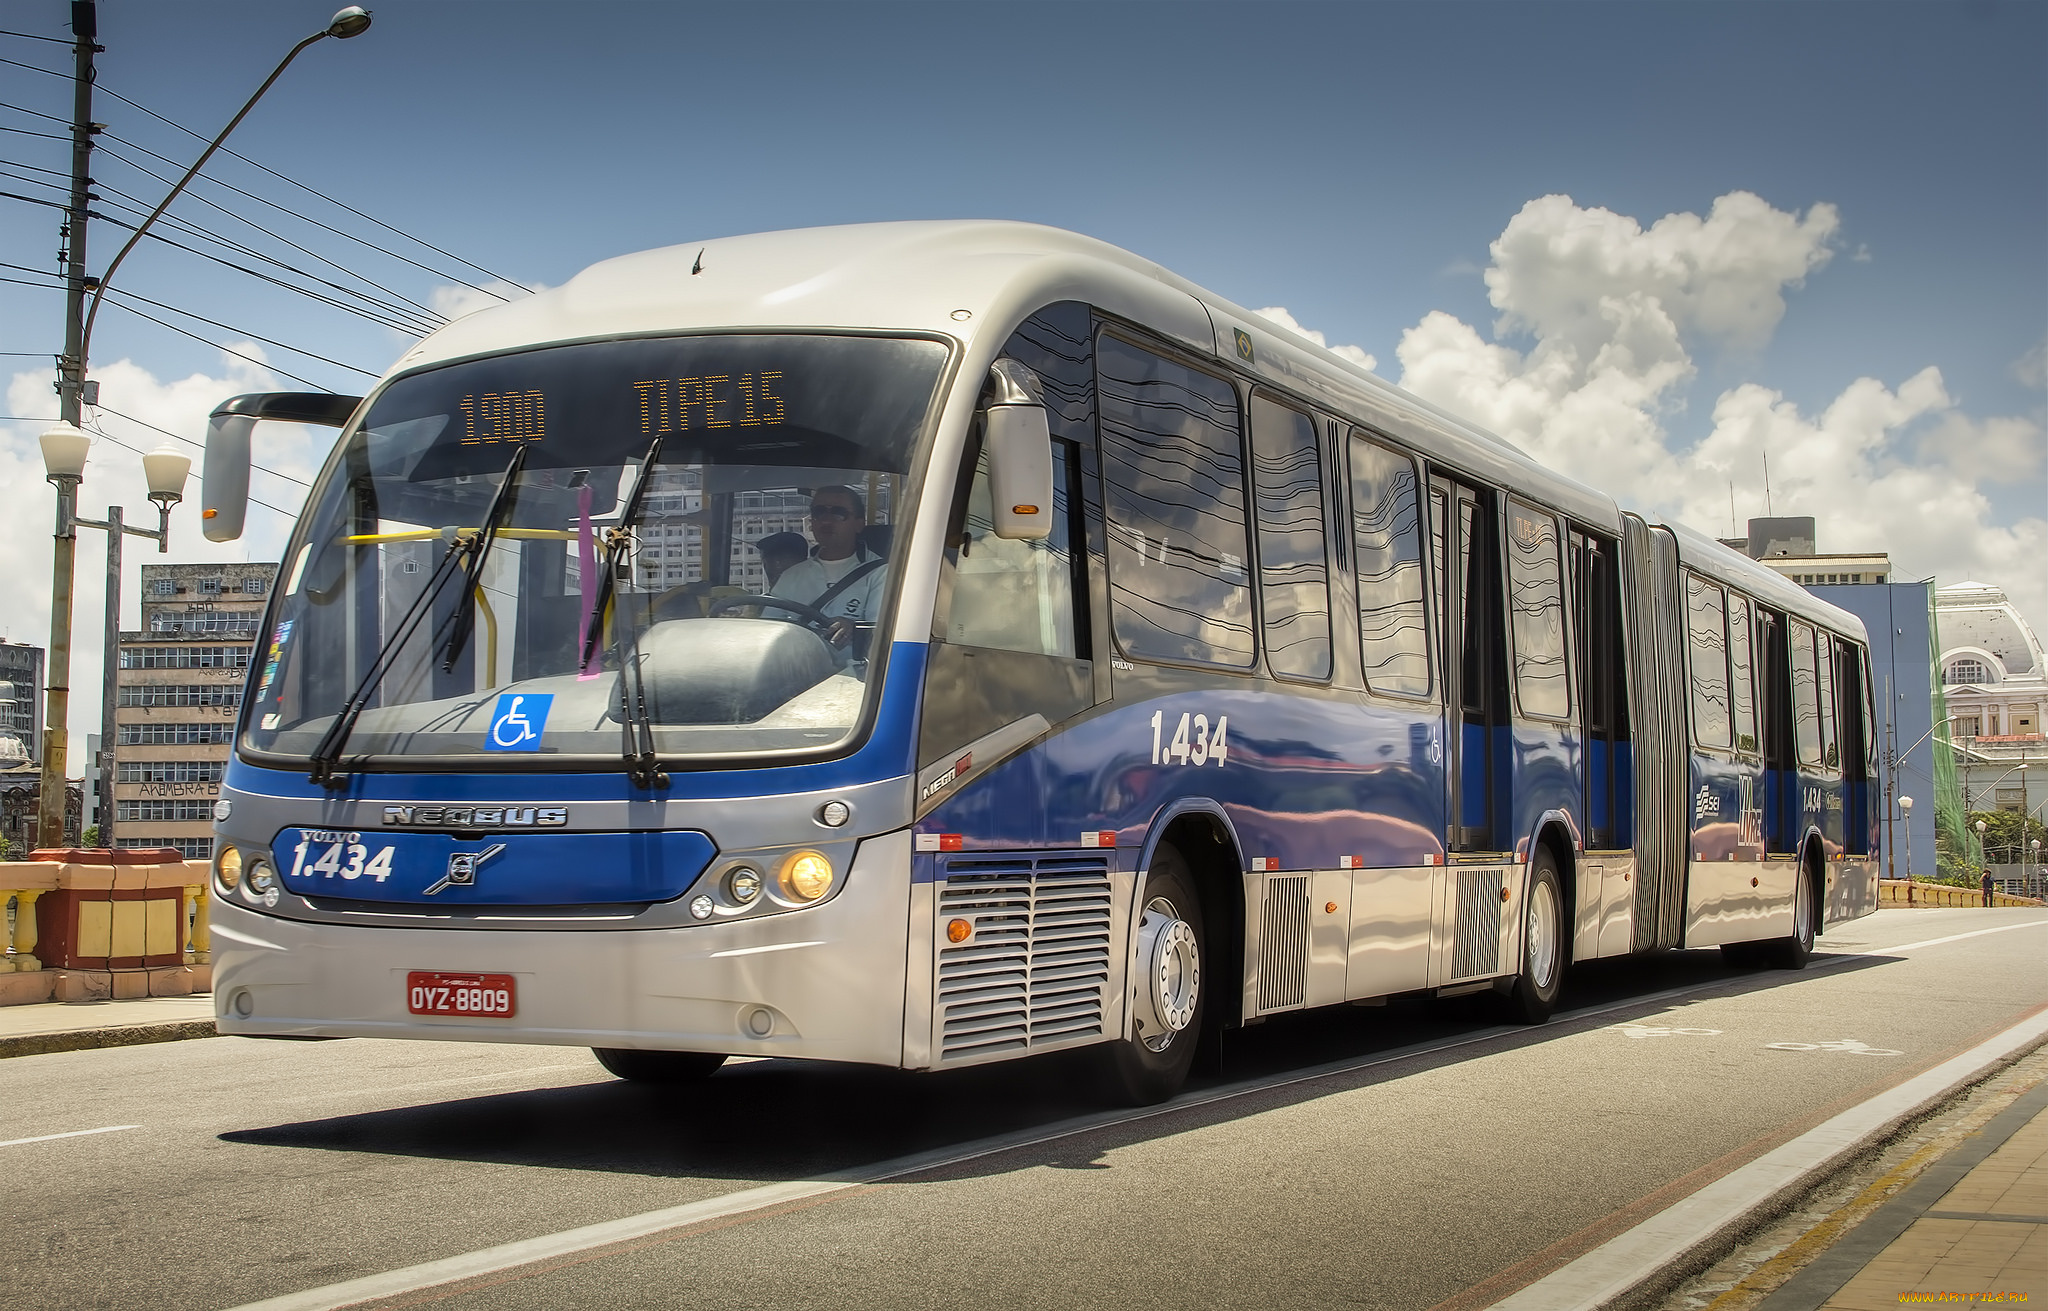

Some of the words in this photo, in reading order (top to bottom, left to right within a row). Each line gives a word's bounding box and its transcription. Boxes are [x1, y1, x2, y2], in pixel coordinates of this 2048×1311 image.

[459, 389, 545, 445] 1900
[1111, 660, 1134, 671] VOLVO
[1151, 710, 1228, 768] 1.434
[1803, 786, 1821, 813] 1.434
[382, 806, 568, 826] NEOBUS
[299, 830, 361, 844] VOLVO
[290, 842, 395, 882] 1.434
[411, 987, 509, 1012] OYZ-8809
